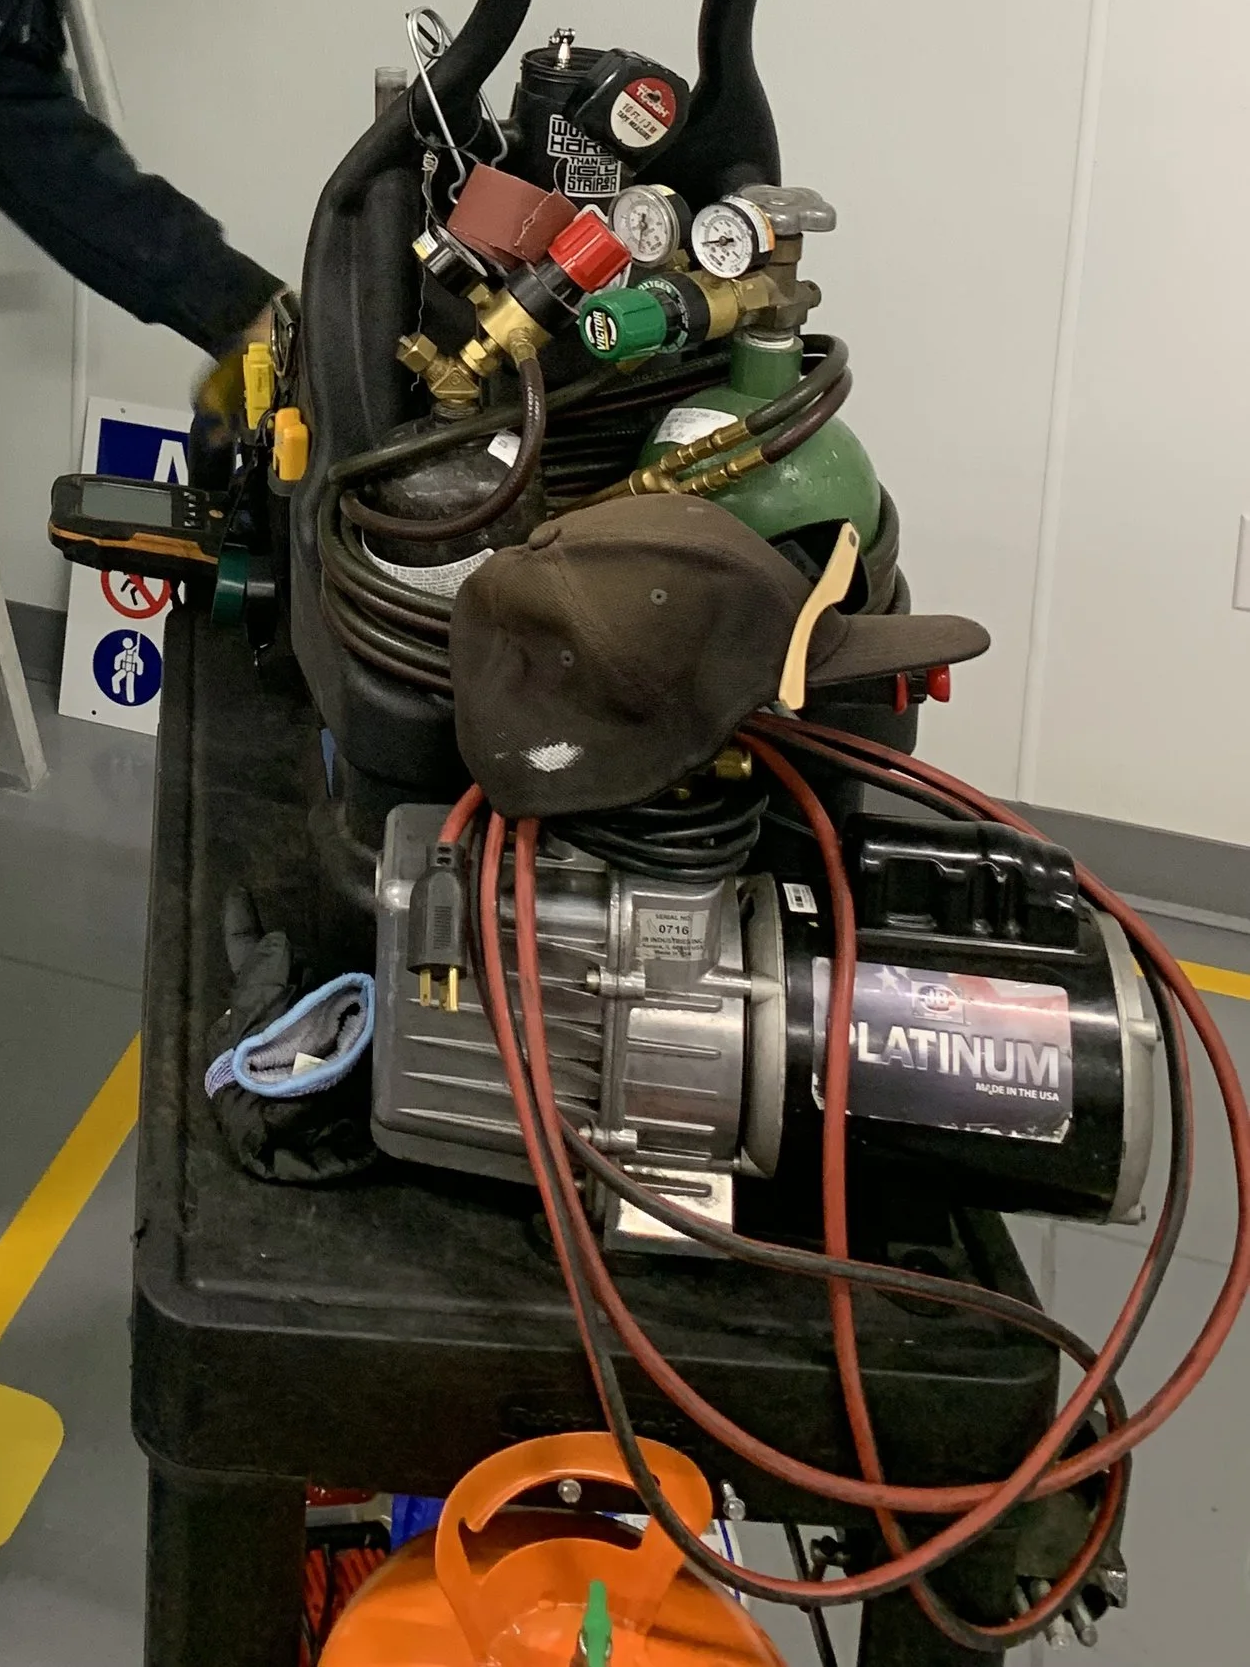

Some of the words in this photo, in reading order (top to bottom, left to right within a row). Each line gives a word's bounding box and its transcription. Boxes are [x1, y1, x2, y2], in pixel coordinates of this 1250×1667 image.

[622, 103, 634, 113] 10
[569, 165, 617, 176] UGLY
[637, 280, 672, 294] OXYGEN
[593, 310, 606, 351] VICTOR
[658, 924, 690, 935] 0716
[975, 1082, 1005, 1095] MADE
[1006, 1086, 1017, 1096] IN
[1018, 1087, 1038, 1099] THE
[1039, 1090, 1060, 1102] USA
